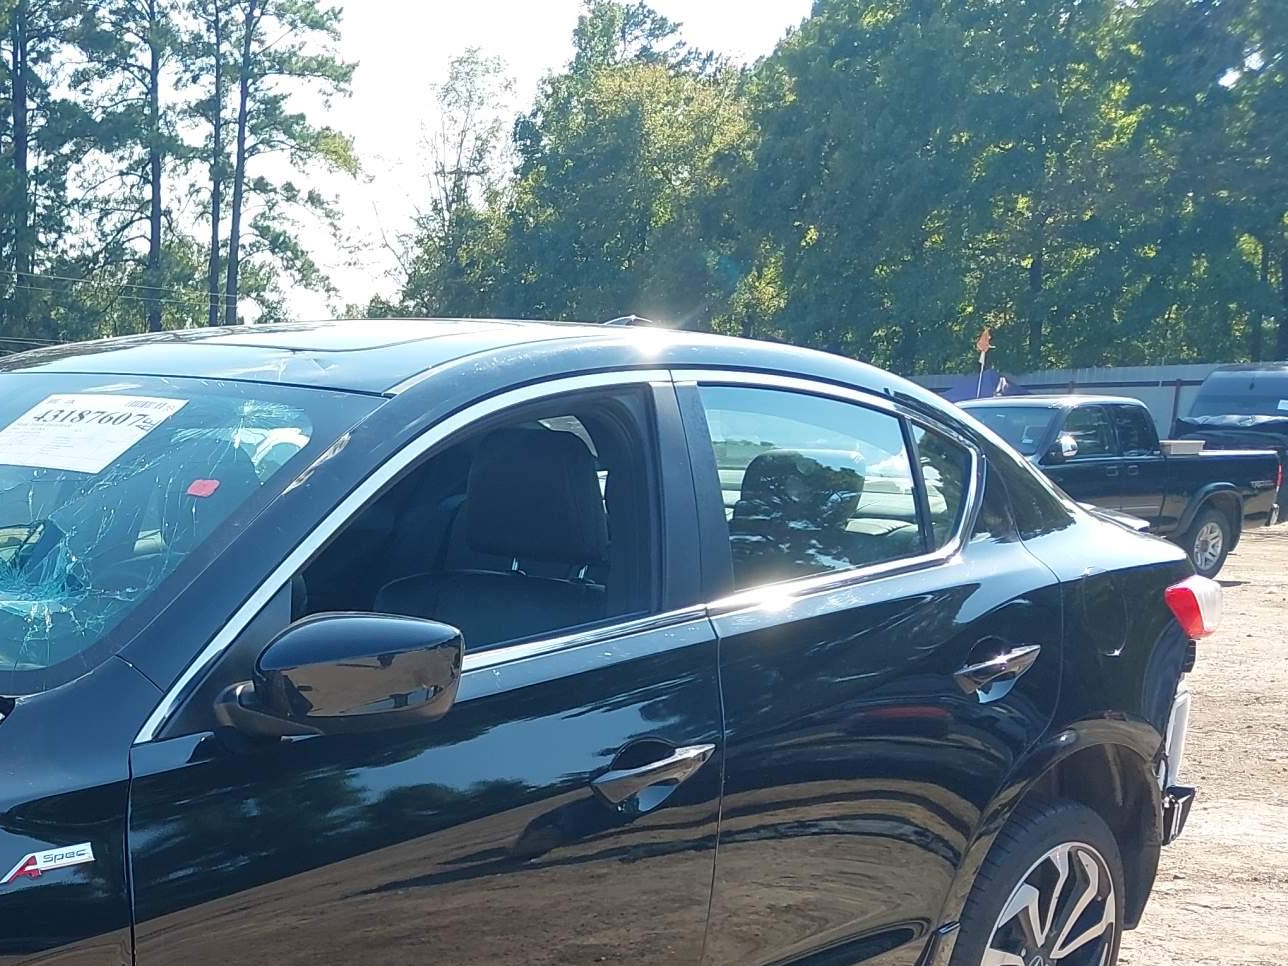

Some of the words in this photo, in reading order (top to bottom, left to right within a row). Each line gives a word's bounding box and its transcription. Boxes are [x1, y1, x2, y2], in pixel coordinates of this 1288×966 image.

[33, 409, 149, 427] 43187607
[0, 853, 40, 885] A
[43, 849, 87, 863] Spec
